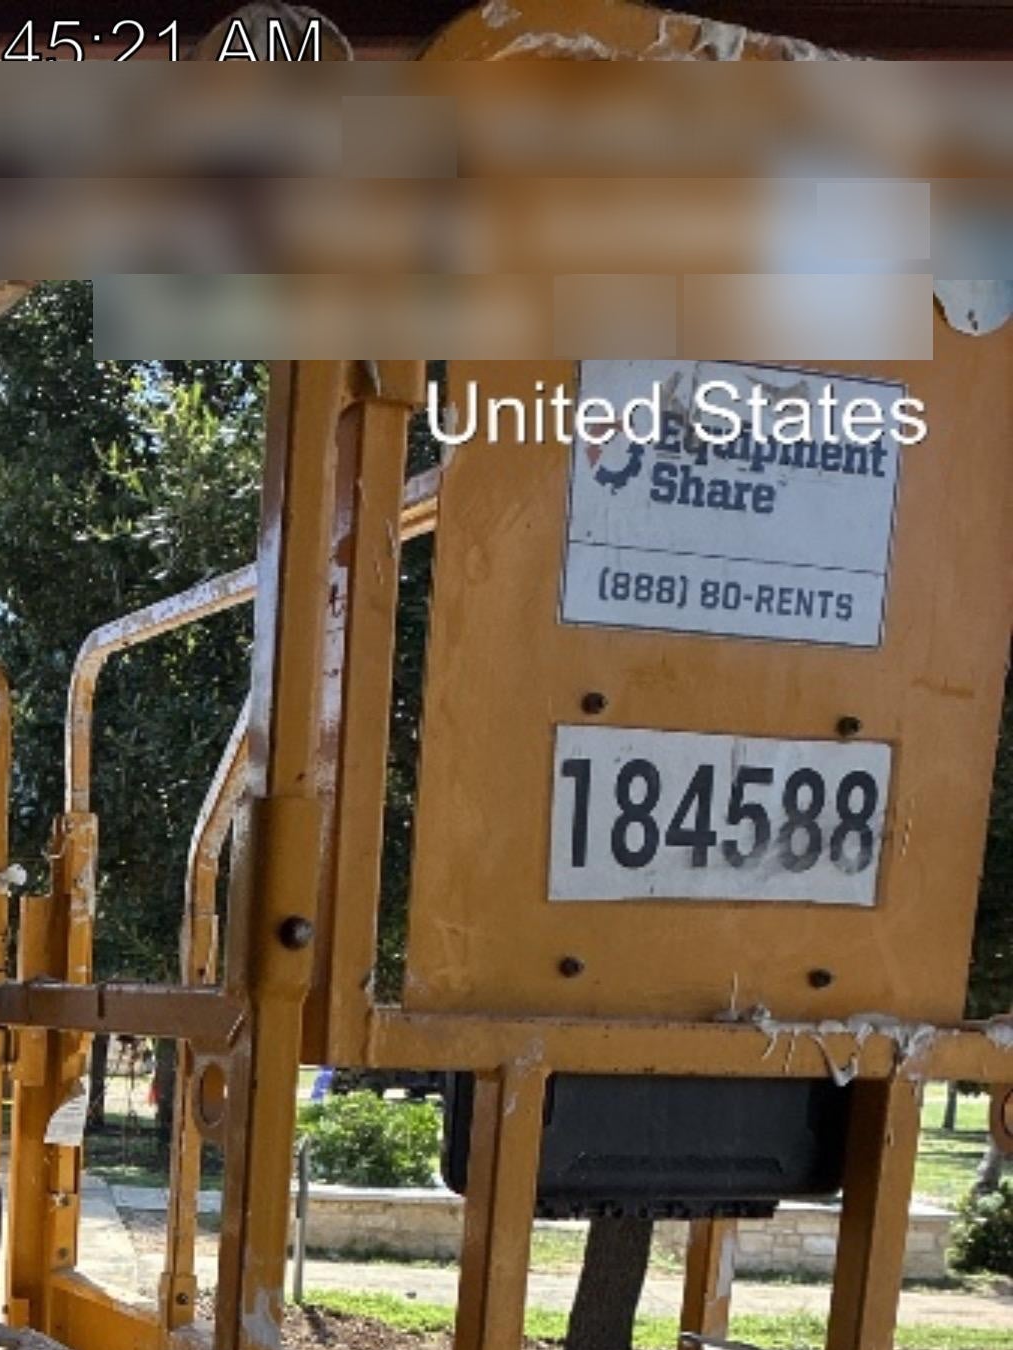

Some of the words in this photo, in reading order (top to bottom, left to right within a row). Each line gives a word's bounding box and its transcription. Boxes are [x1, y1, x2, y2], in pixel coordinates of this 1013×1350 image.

[649, 461, 776, 513] Share
[598, 566, 688, 608] (888)
[700, 580, 853, 621] 80-RENTS
[561, 758, 878, 873] 184588
